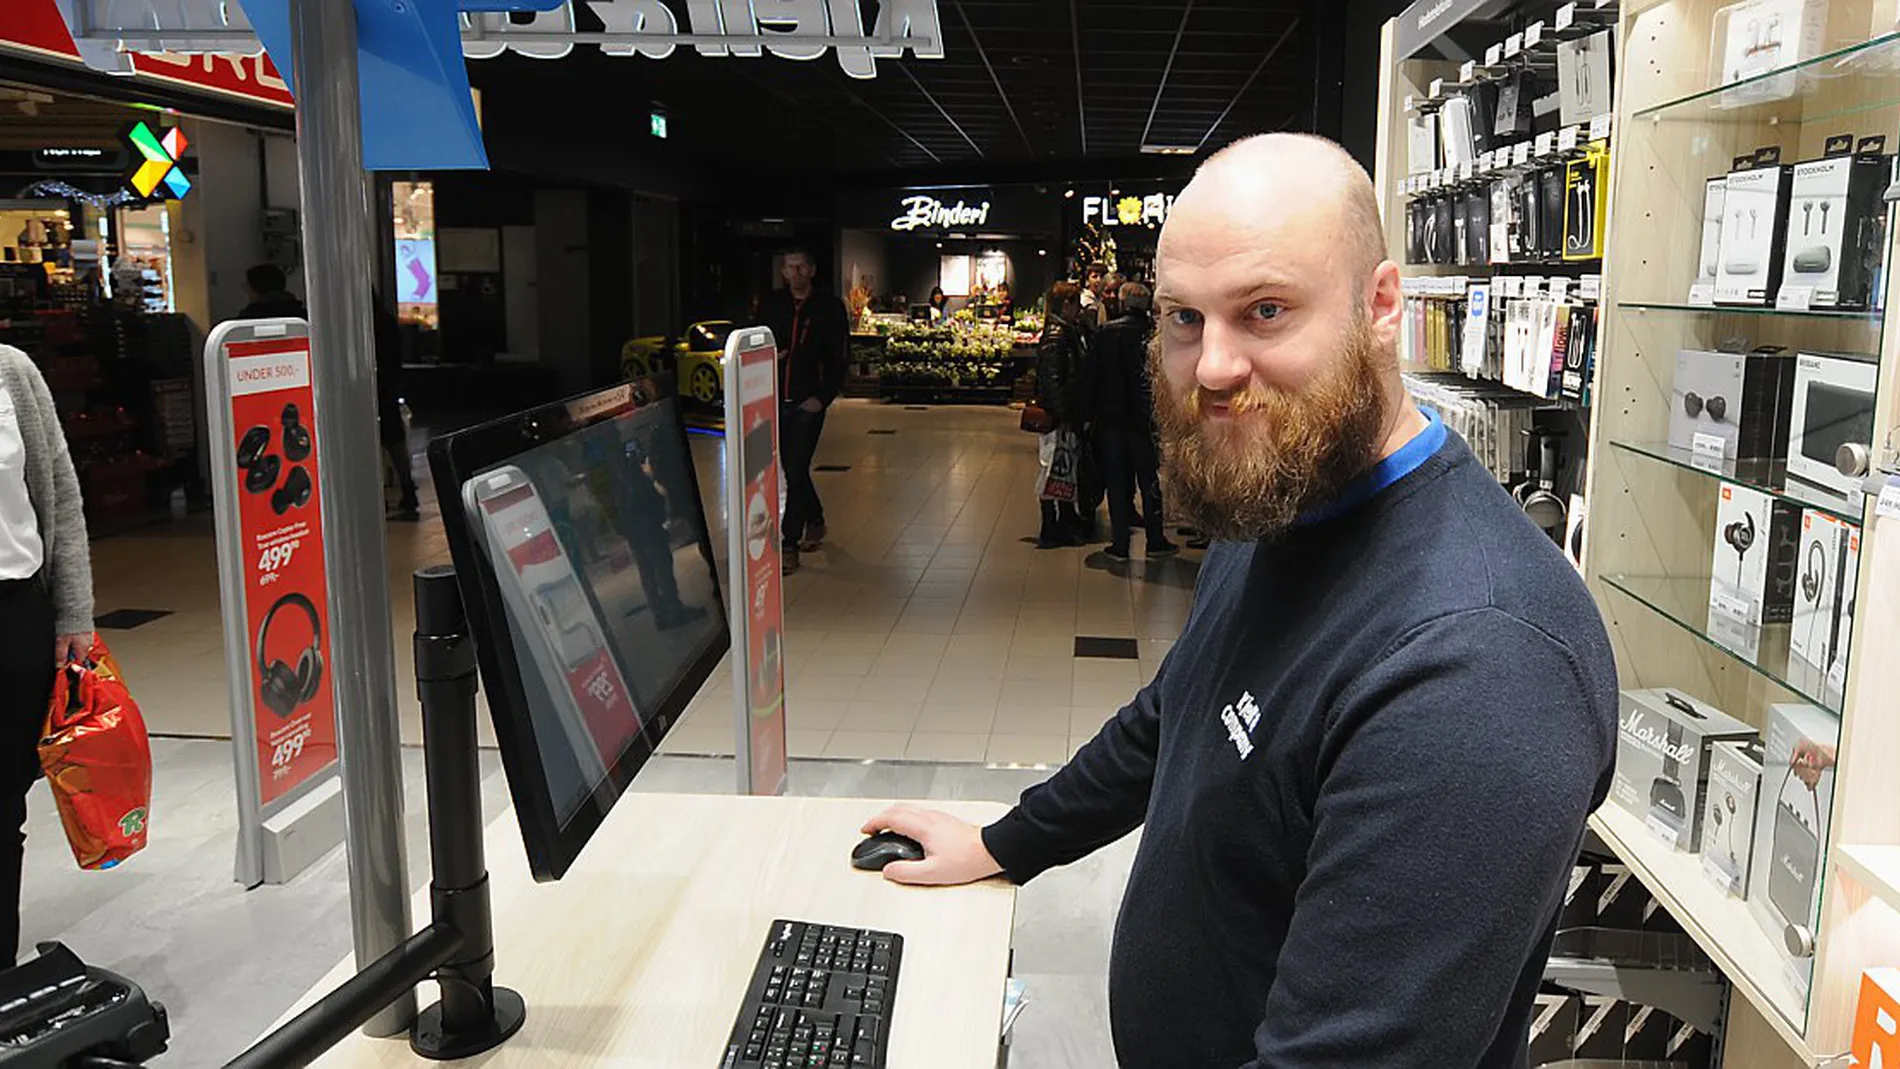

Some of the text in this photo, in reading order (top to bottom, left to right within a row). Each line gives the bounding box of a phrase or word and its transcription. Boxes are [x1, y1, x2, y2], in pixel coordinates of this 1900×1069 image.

[892, 196, 989, 230] Binderi
[237, 367, 272, 382] UNDER
[1619, 708, 1694, 765] Marshall
